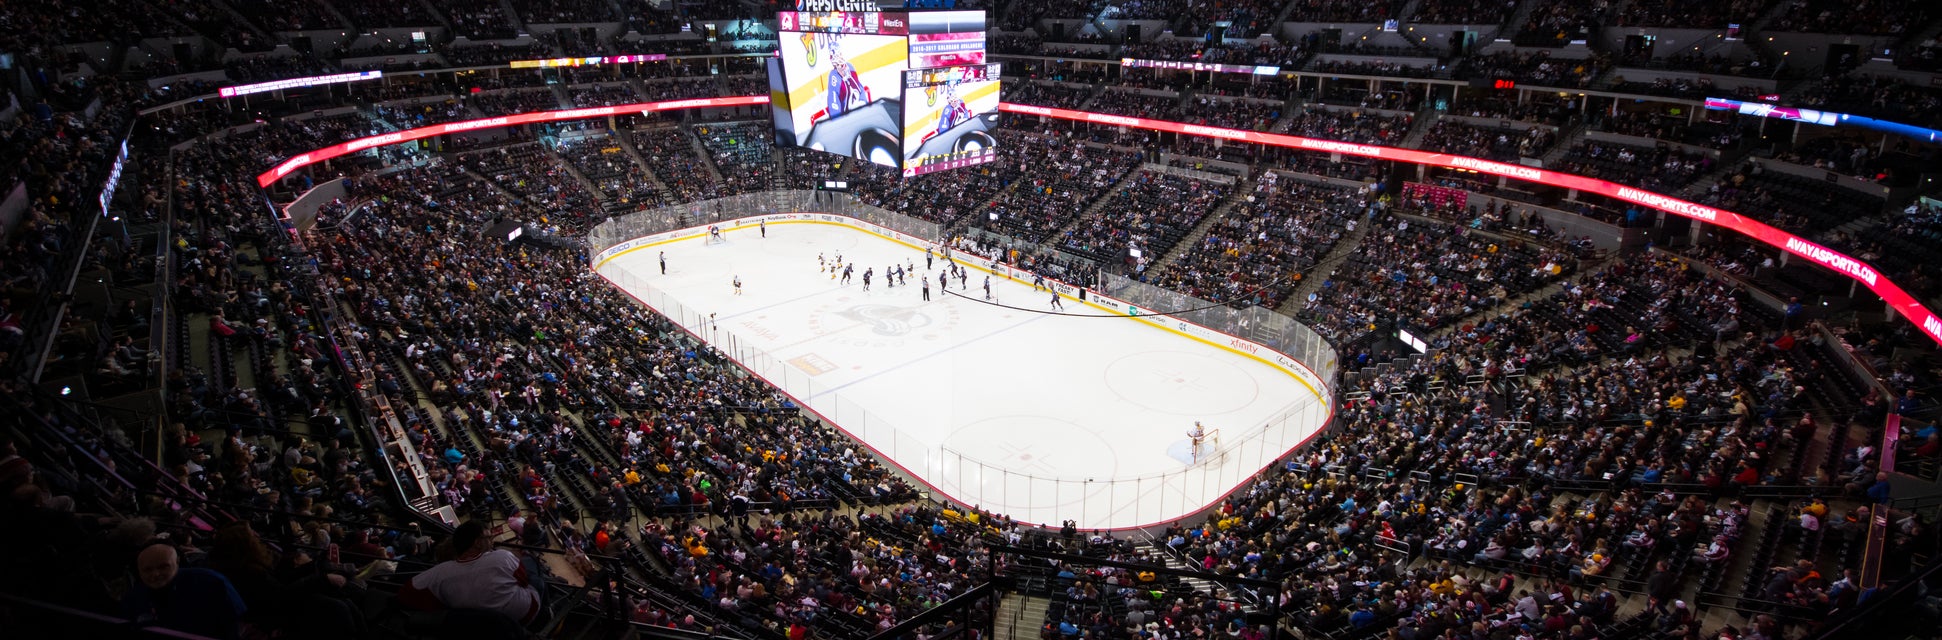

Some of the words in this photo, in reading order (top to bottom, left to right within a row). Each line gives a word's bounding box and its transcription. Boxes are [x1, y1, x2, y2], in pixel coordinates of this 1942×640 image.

[806, 0, 835, 12] PEPSI
[1451, 157, 1541, 180] AVAYASPORTS.COM
[1617, 188, 1716, 221] AVAYASPORTS.COM
[608, 243, 630, 256] GEICO
[1786, 237, 1877, 286] AVAYASPORTS.COM
[1230, 339, 1258, 354] xfinity
